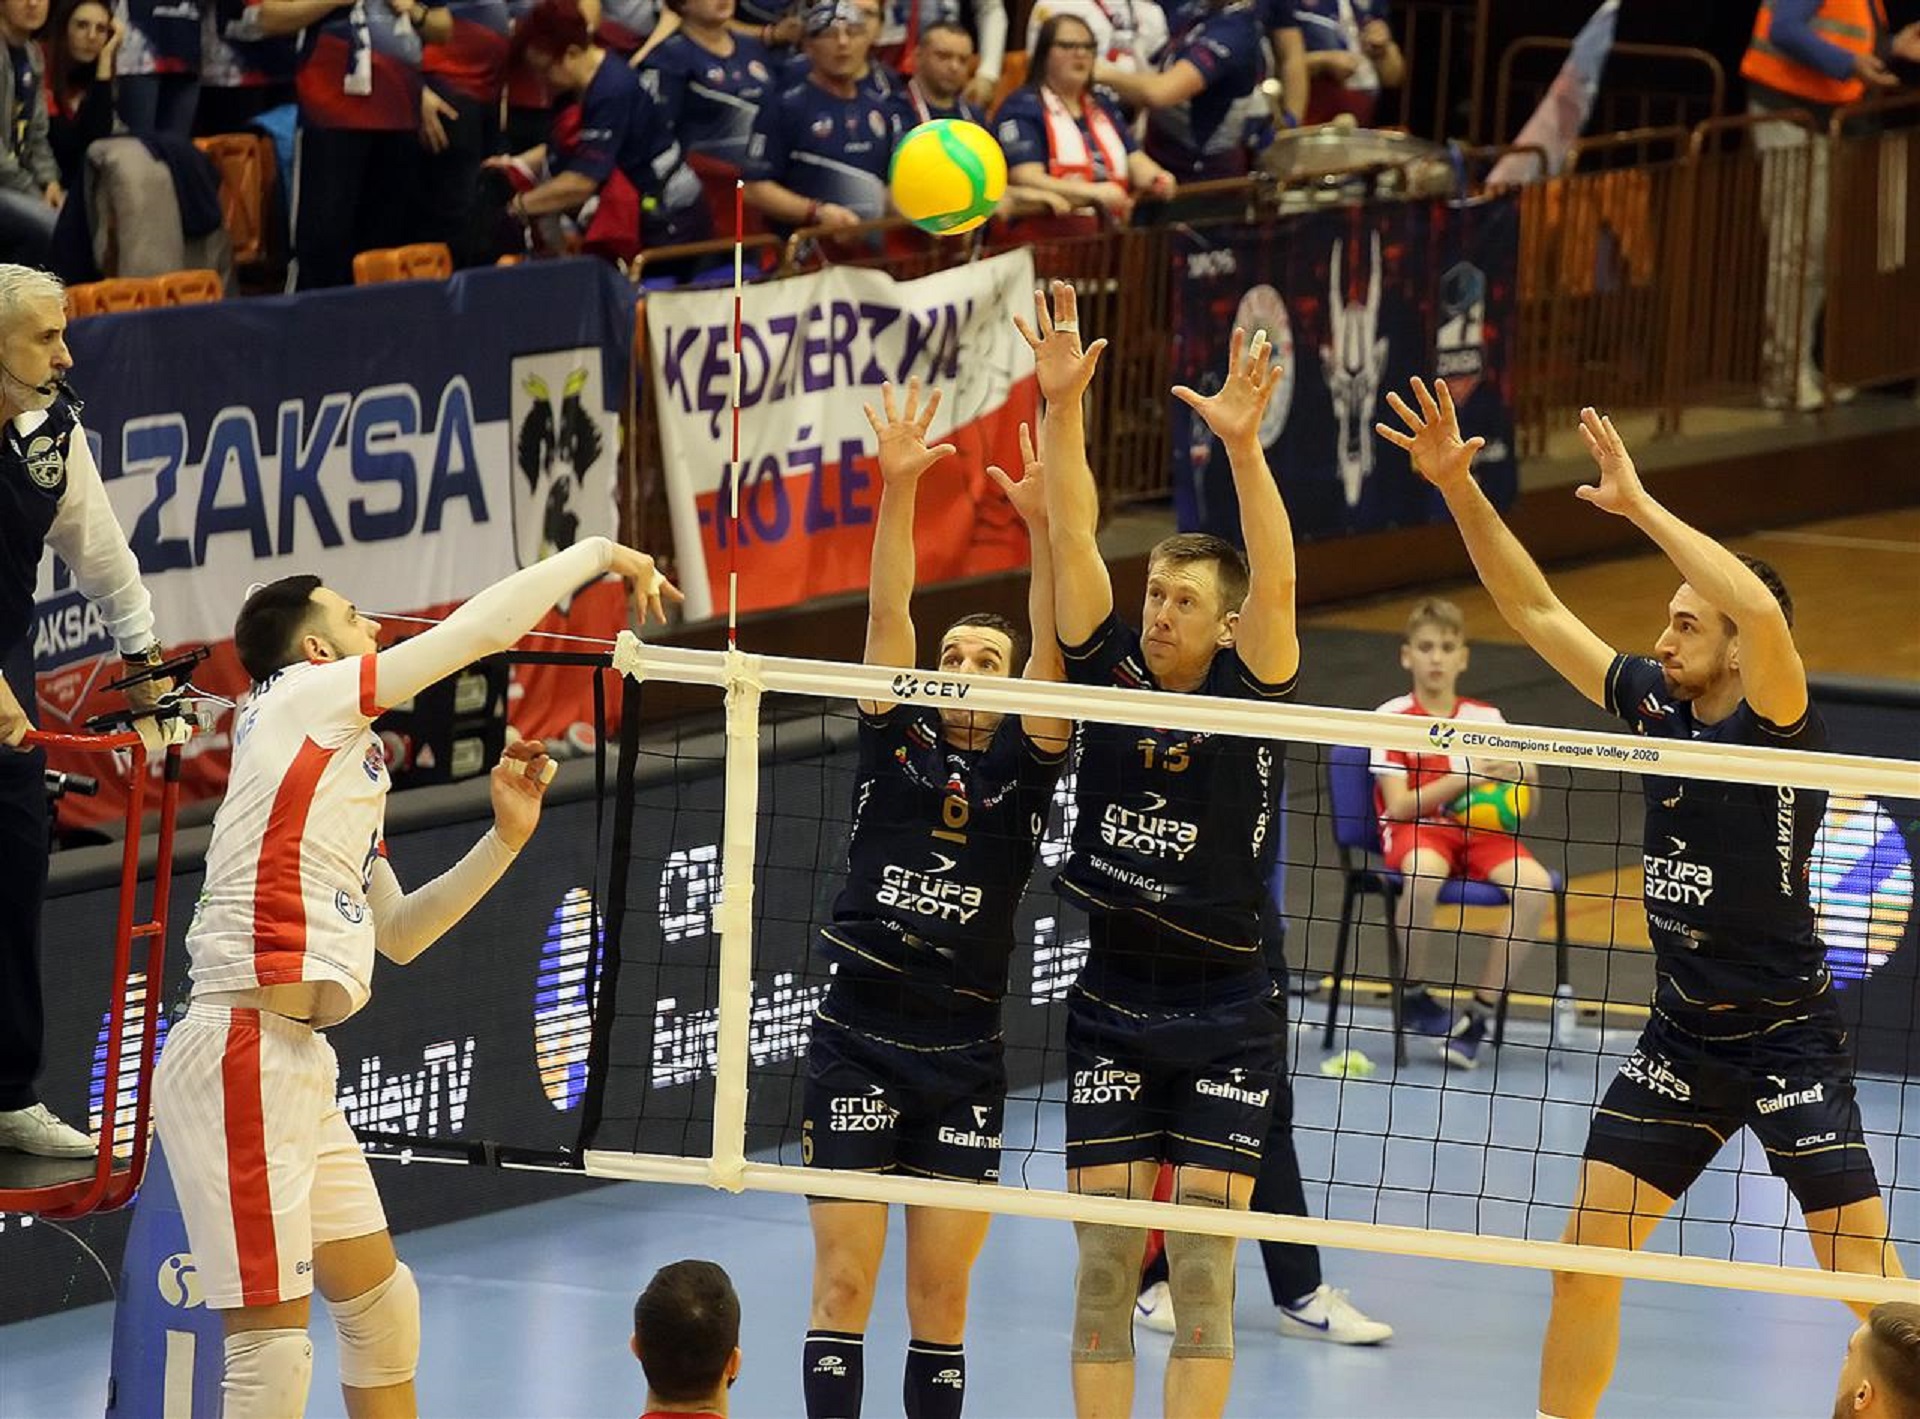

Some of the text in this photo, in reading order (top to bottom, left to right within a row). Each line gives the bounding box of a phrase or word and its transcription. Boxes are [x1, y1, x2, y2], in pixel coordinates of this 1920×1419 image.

[122, 374, 490, 574] ZAKSA
[34, 601, 107, 660] AKSA
[923, 681, 971, 699] CEV
[1137, 737, 1191, 773] 15
[1462, 733, 1659, 762] CEV Champions League Volley 2020
[1195, 1078, 1270, 1108] Galmet
[1756, 1081, 1824, 1115] Galmet
[938, 1126, 1002, 1149] Galme
[1796, 1132, 1837, 1147] COLO
